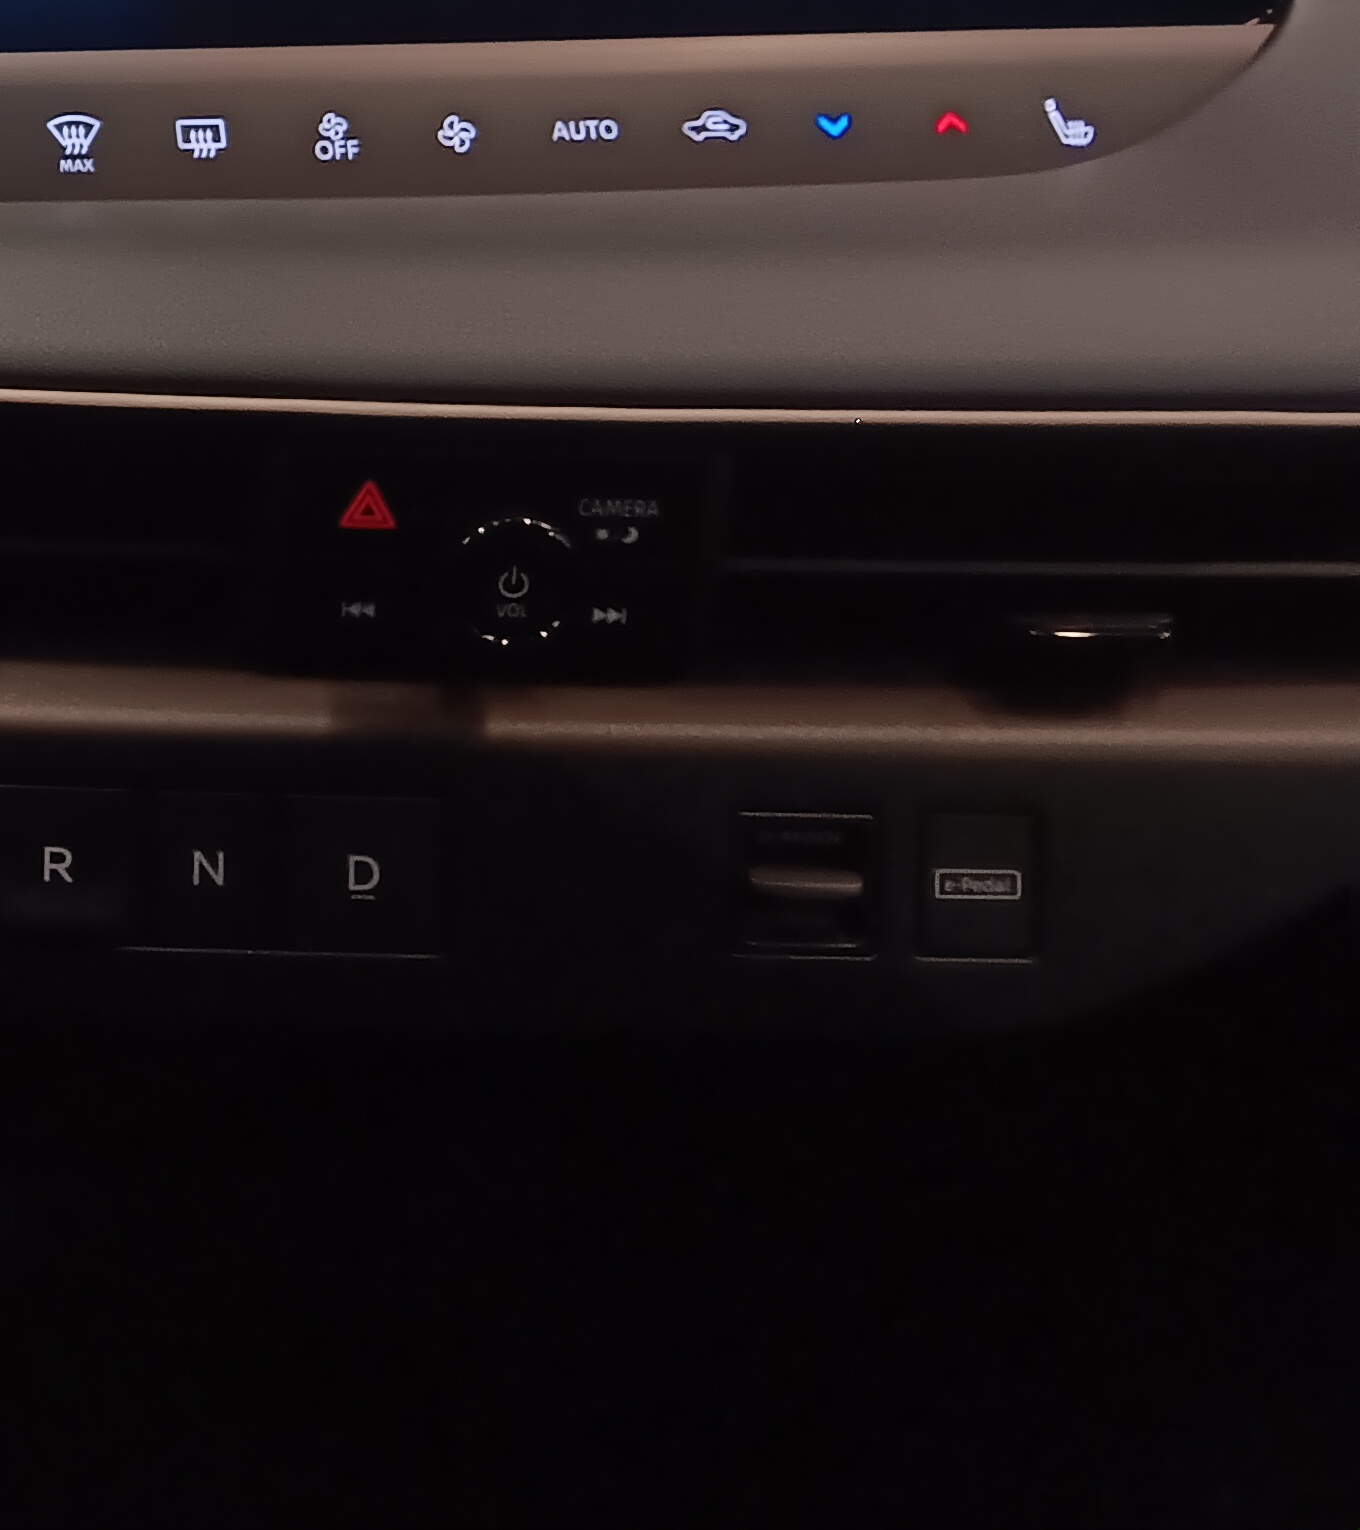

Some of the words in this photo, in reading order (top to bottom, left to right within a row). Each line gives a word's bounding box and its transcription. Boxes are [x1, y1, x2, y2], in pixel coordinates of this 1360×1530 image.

[552, 118, 619, 141] AUTO
[314, 139, 360, 161] OFF
[59, 157, 95, 173] MAX
[580, 498, 659, 517] CAMERA
[496, 602, 527, 618] VOL
[43, 846, 73, 883] R
[193, 850, 224, 886] N
[348, 855, 380, 891] D
